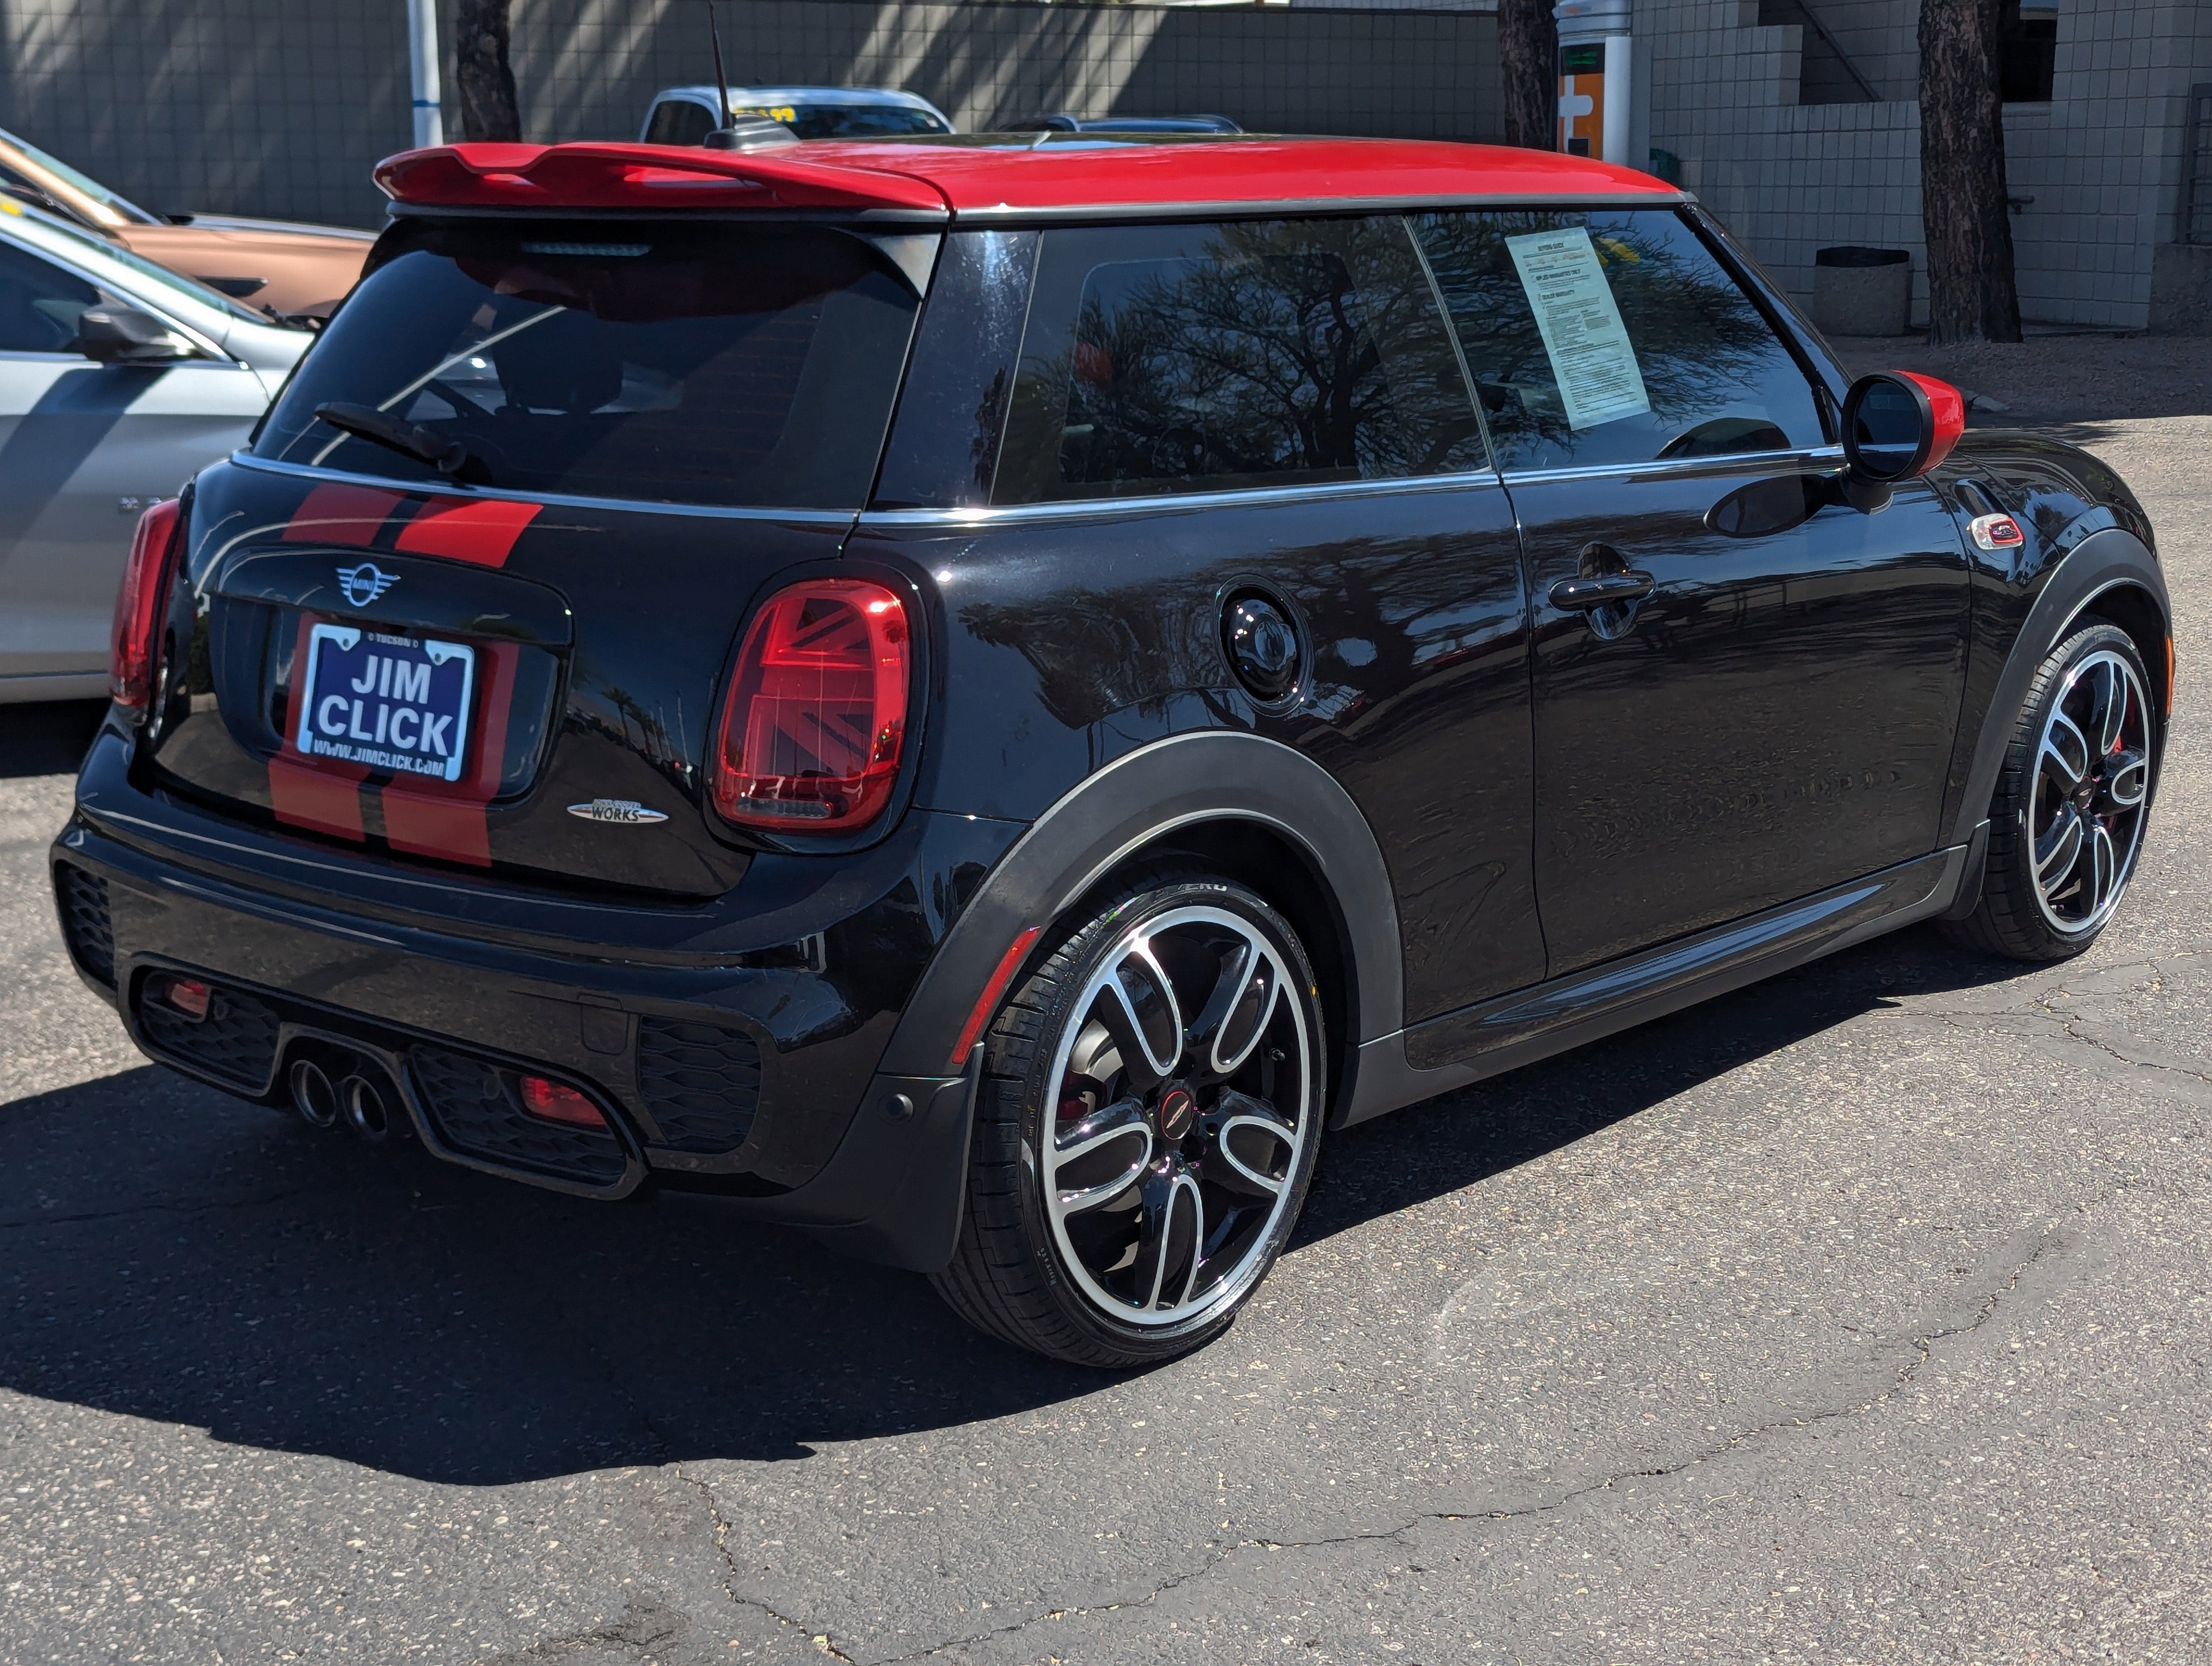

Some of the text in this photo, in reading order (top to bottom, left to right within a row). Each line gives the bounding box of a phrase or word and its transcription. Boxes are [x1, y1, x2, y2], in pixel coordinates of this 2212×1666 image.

[352, 578, 375, 592] MINI
[377, 633, 411, 648] TUCSON
[352, 654, 432, 704] JIM
[318, 695, 453, 756] CLICK
[592, 806, 640, 822] WORKS
